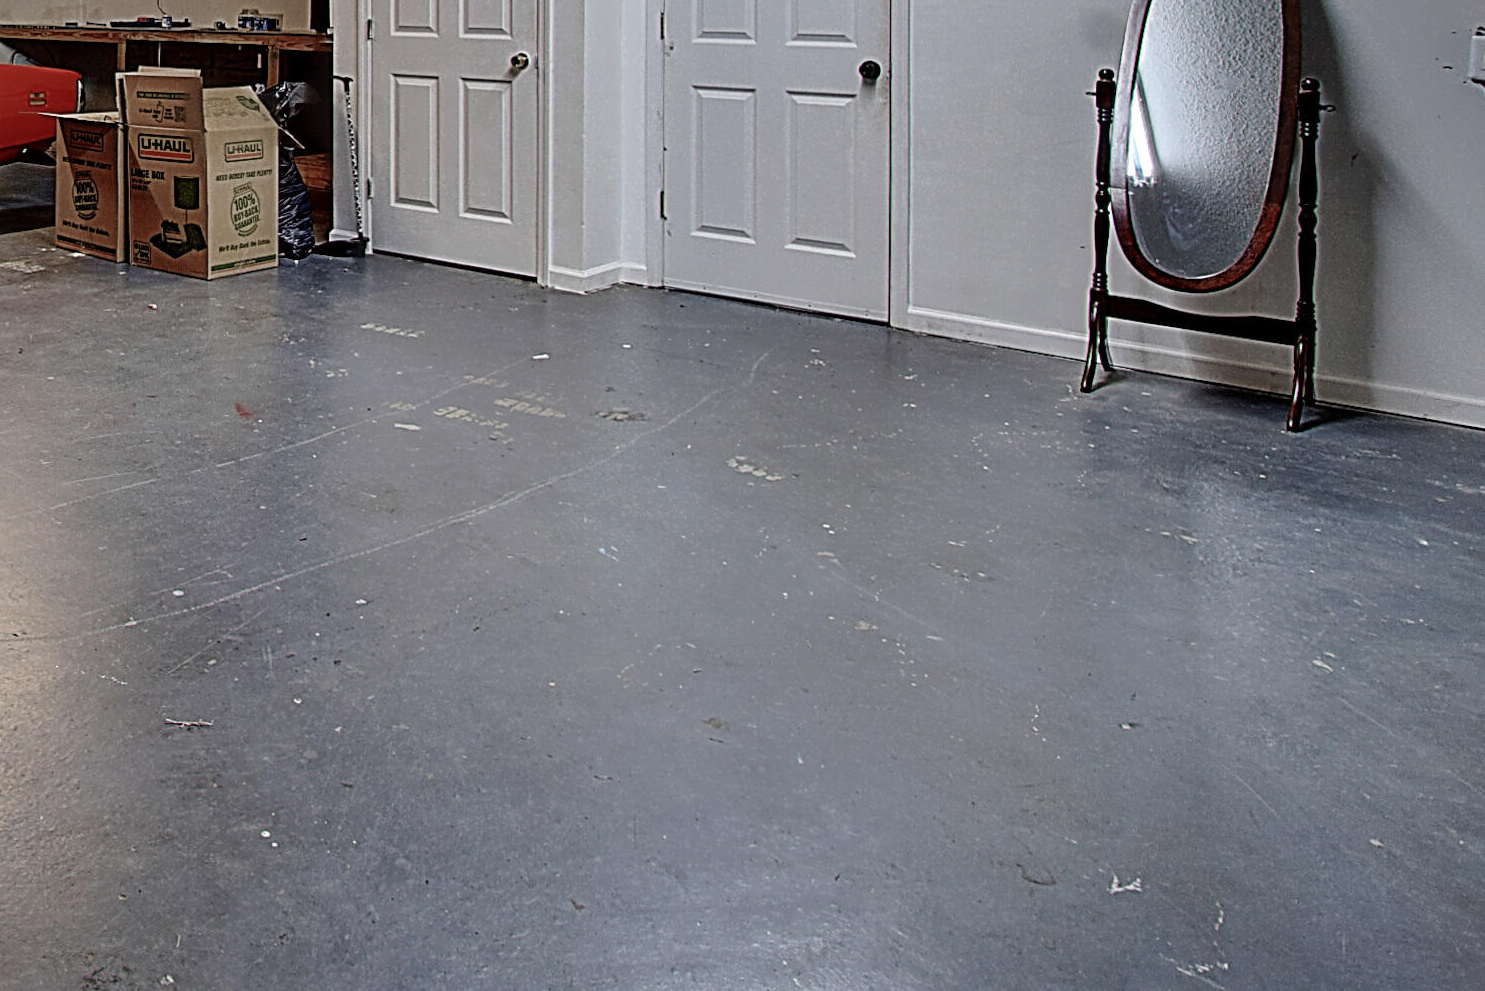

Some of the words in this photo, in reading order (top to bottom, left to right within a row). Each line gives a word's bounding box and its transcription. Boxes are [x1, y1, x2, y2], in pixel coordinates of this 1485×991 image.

[71, 131, 102, 145] U-HAUL
[141, 137, 191, 154] U-HAUL
[227, 143, 261, 155] U-HAUL
[131, 168, 150, 179] LARGE
[152, 170, 165, 180] BOX
[76, 180, 95, 194] 100%
[234, 192, 256, 212] 100%
